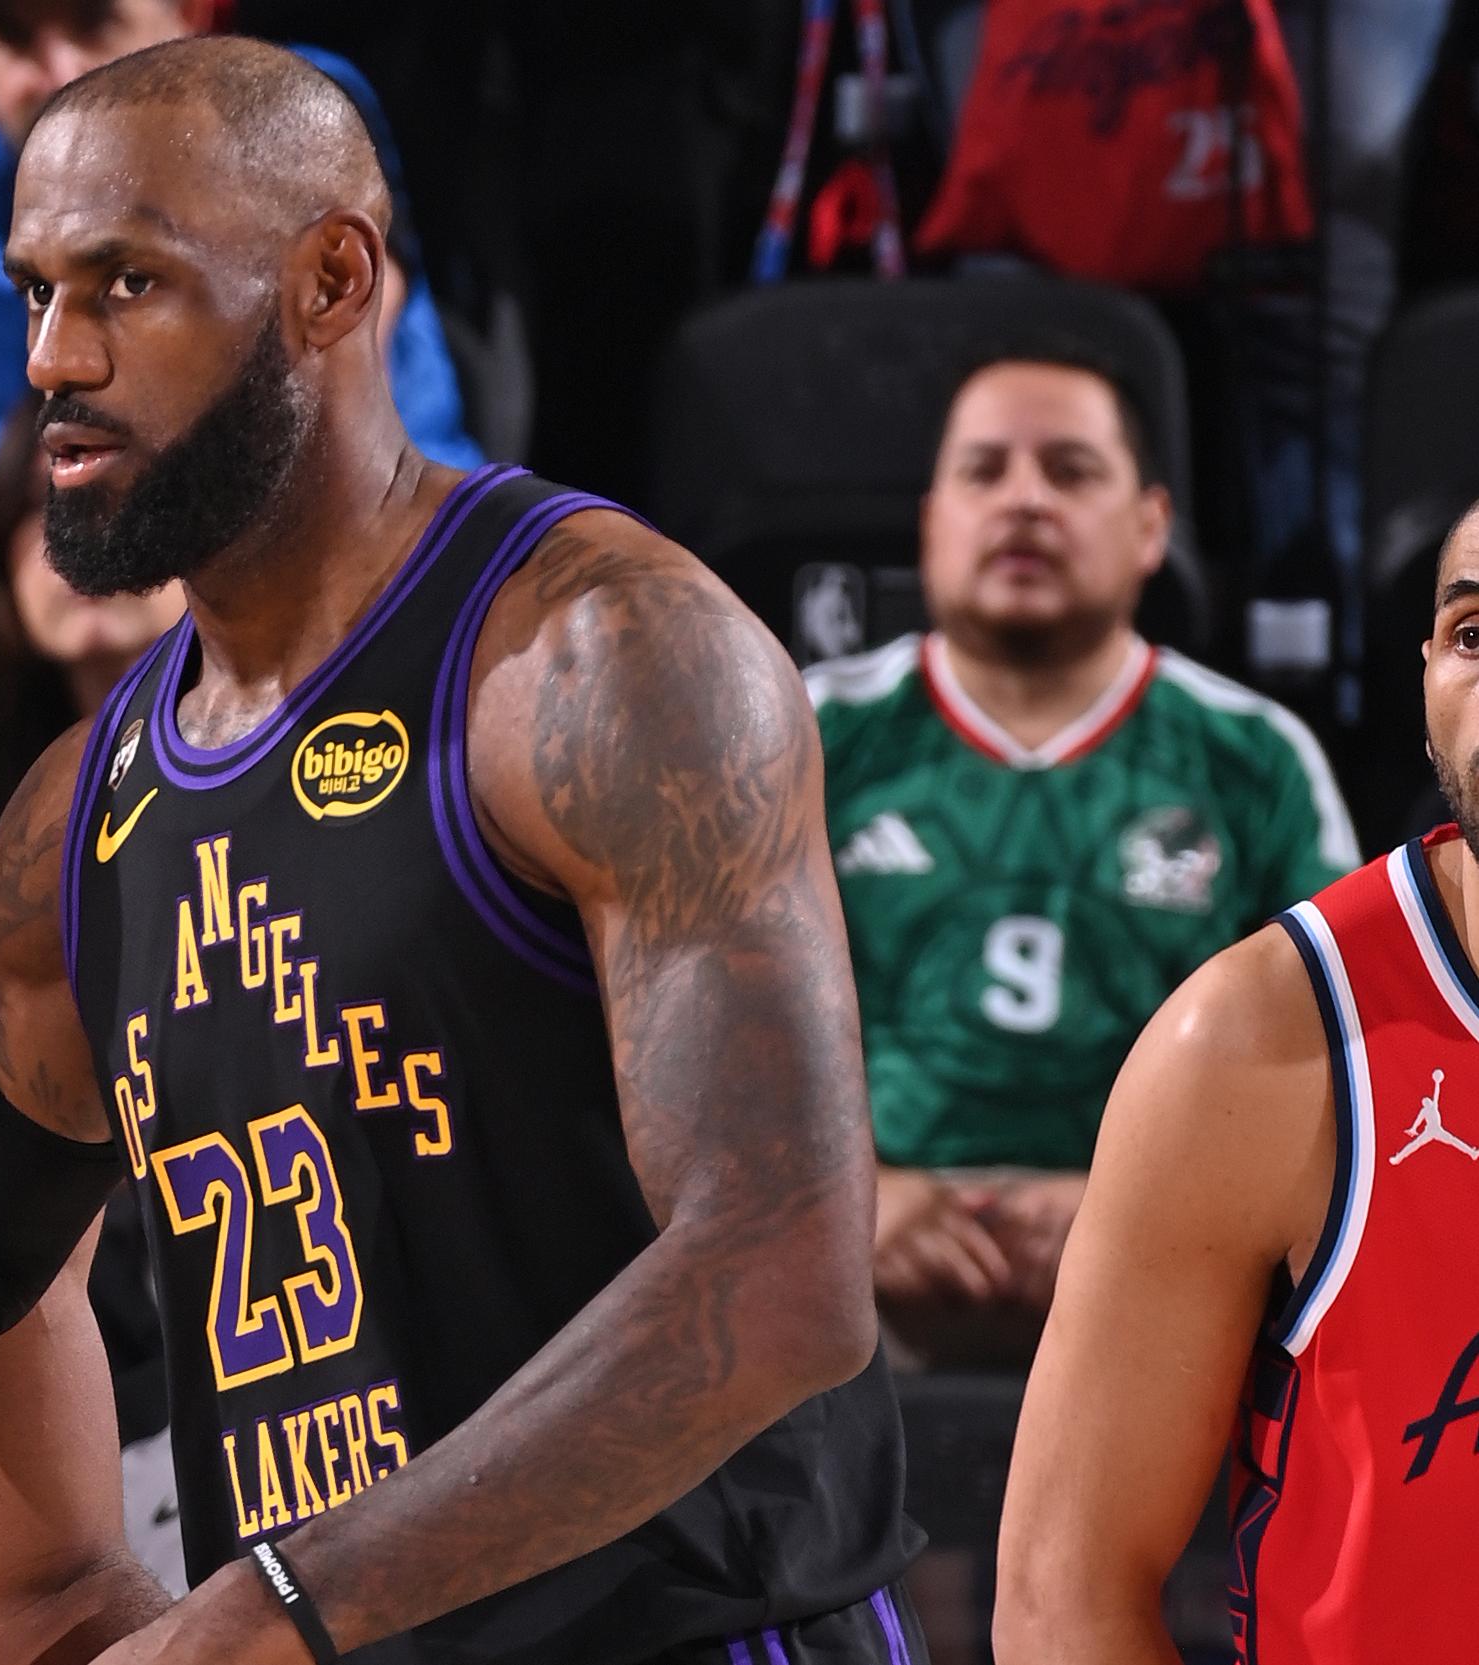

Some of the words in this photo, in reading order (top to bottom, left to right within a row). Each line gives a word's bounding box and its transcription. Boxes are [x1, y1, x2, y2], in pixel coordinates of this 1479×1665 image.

[303, 738, 403, 784] bibigo
[318, 774, 361, 796] 비비고
[113, 1008, 158, 1182] OS
[173, 831, 455, 1159] ANGELES
[980, 913, 1065, 1035] 9
[150, 1103, 364, 1392] 23
[221, 1379, 410, 1541] LAKERS
[252, 1541, 295, 1597] PROMIS
[284, 1592, 300, 1604] I
